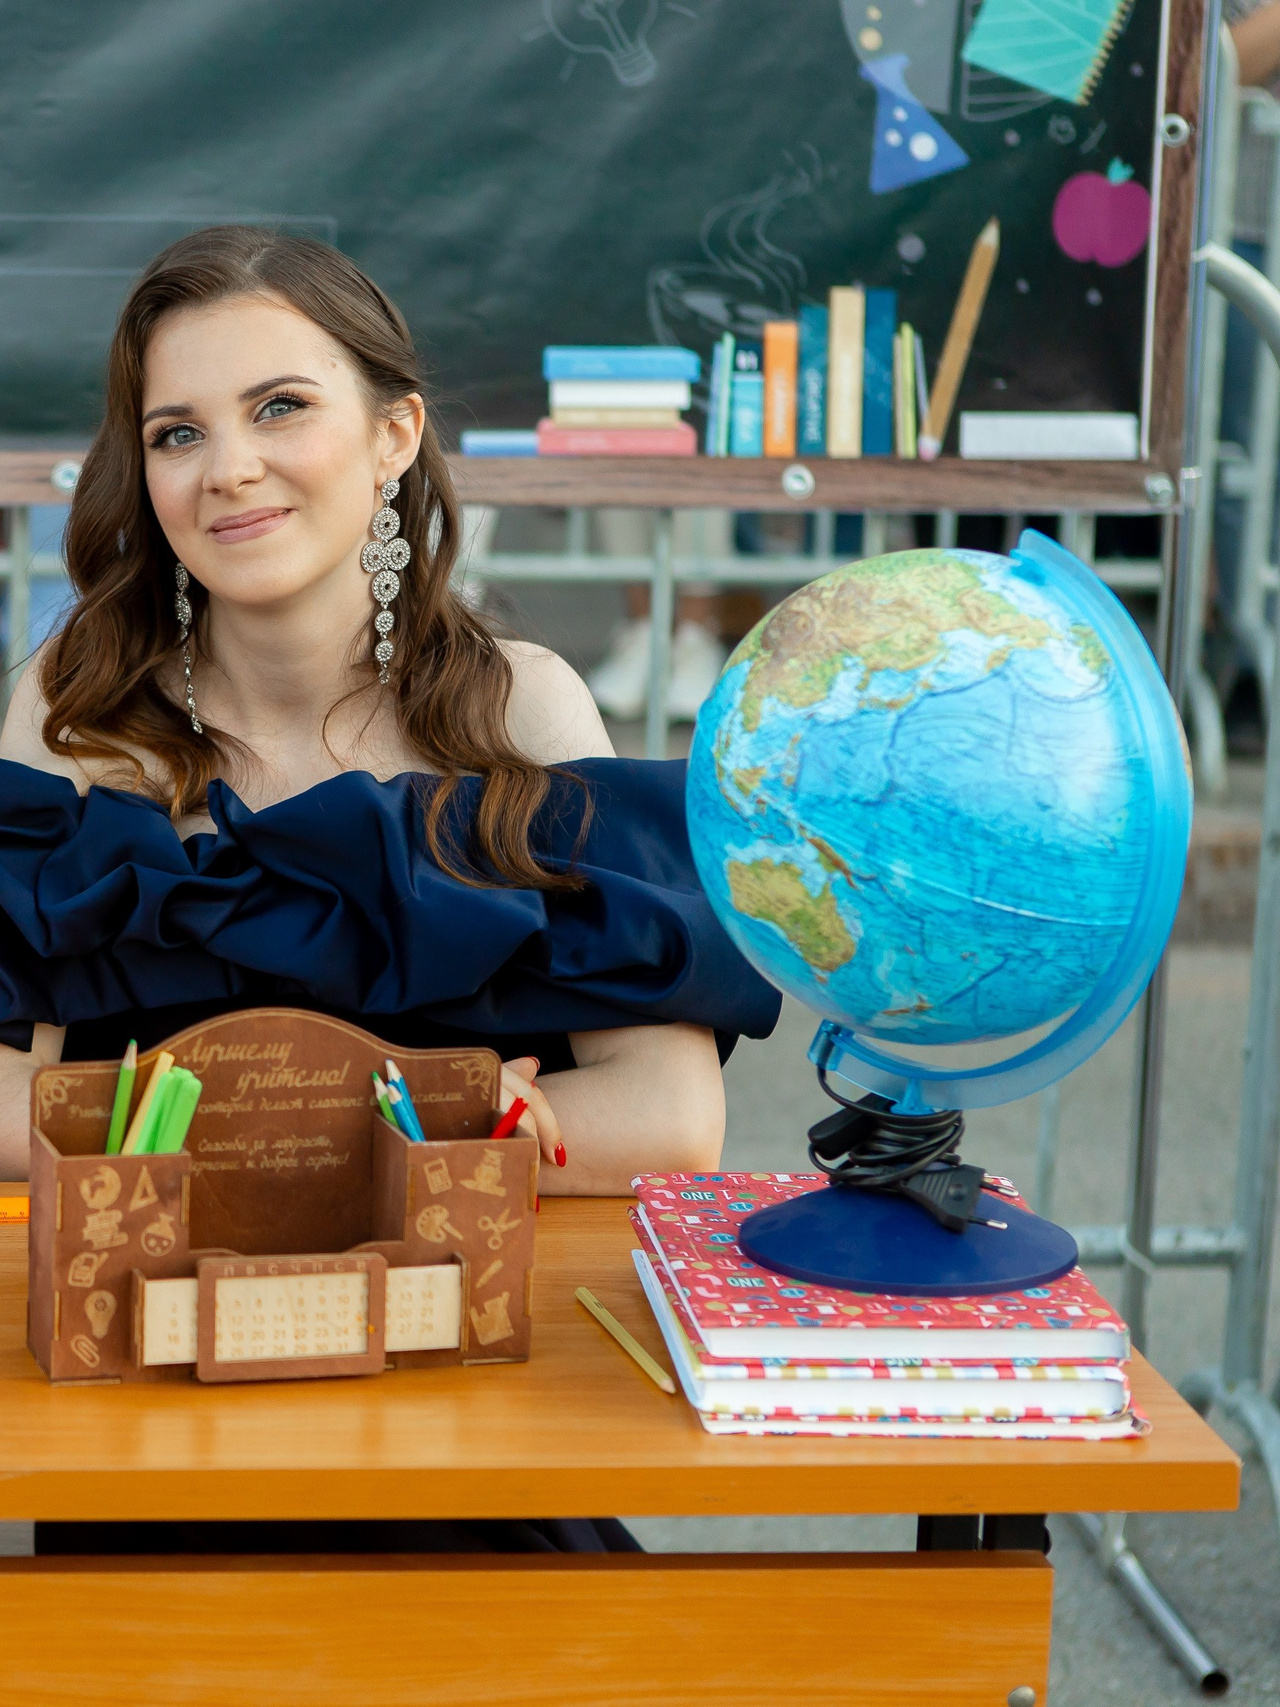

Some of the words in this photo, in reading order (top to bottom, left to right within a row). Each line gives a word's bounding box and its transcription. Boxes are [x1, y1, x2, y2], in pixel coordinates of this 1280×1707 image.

[182, 1036, 294, 1074] Лучшему
[230, 1060, 351, 1101] учителю!
[198, 1133, 247, 1152] Спасибо
[248, 1138, 267, 1156] за
[680, 1191, 716, 1201] ONE
[223, 1264, 235, 1276] П
[268, 1263, 279, 1275] С
[334, 1260, 345, 1272] С
[726, 1276, 766, 1288] ONE
